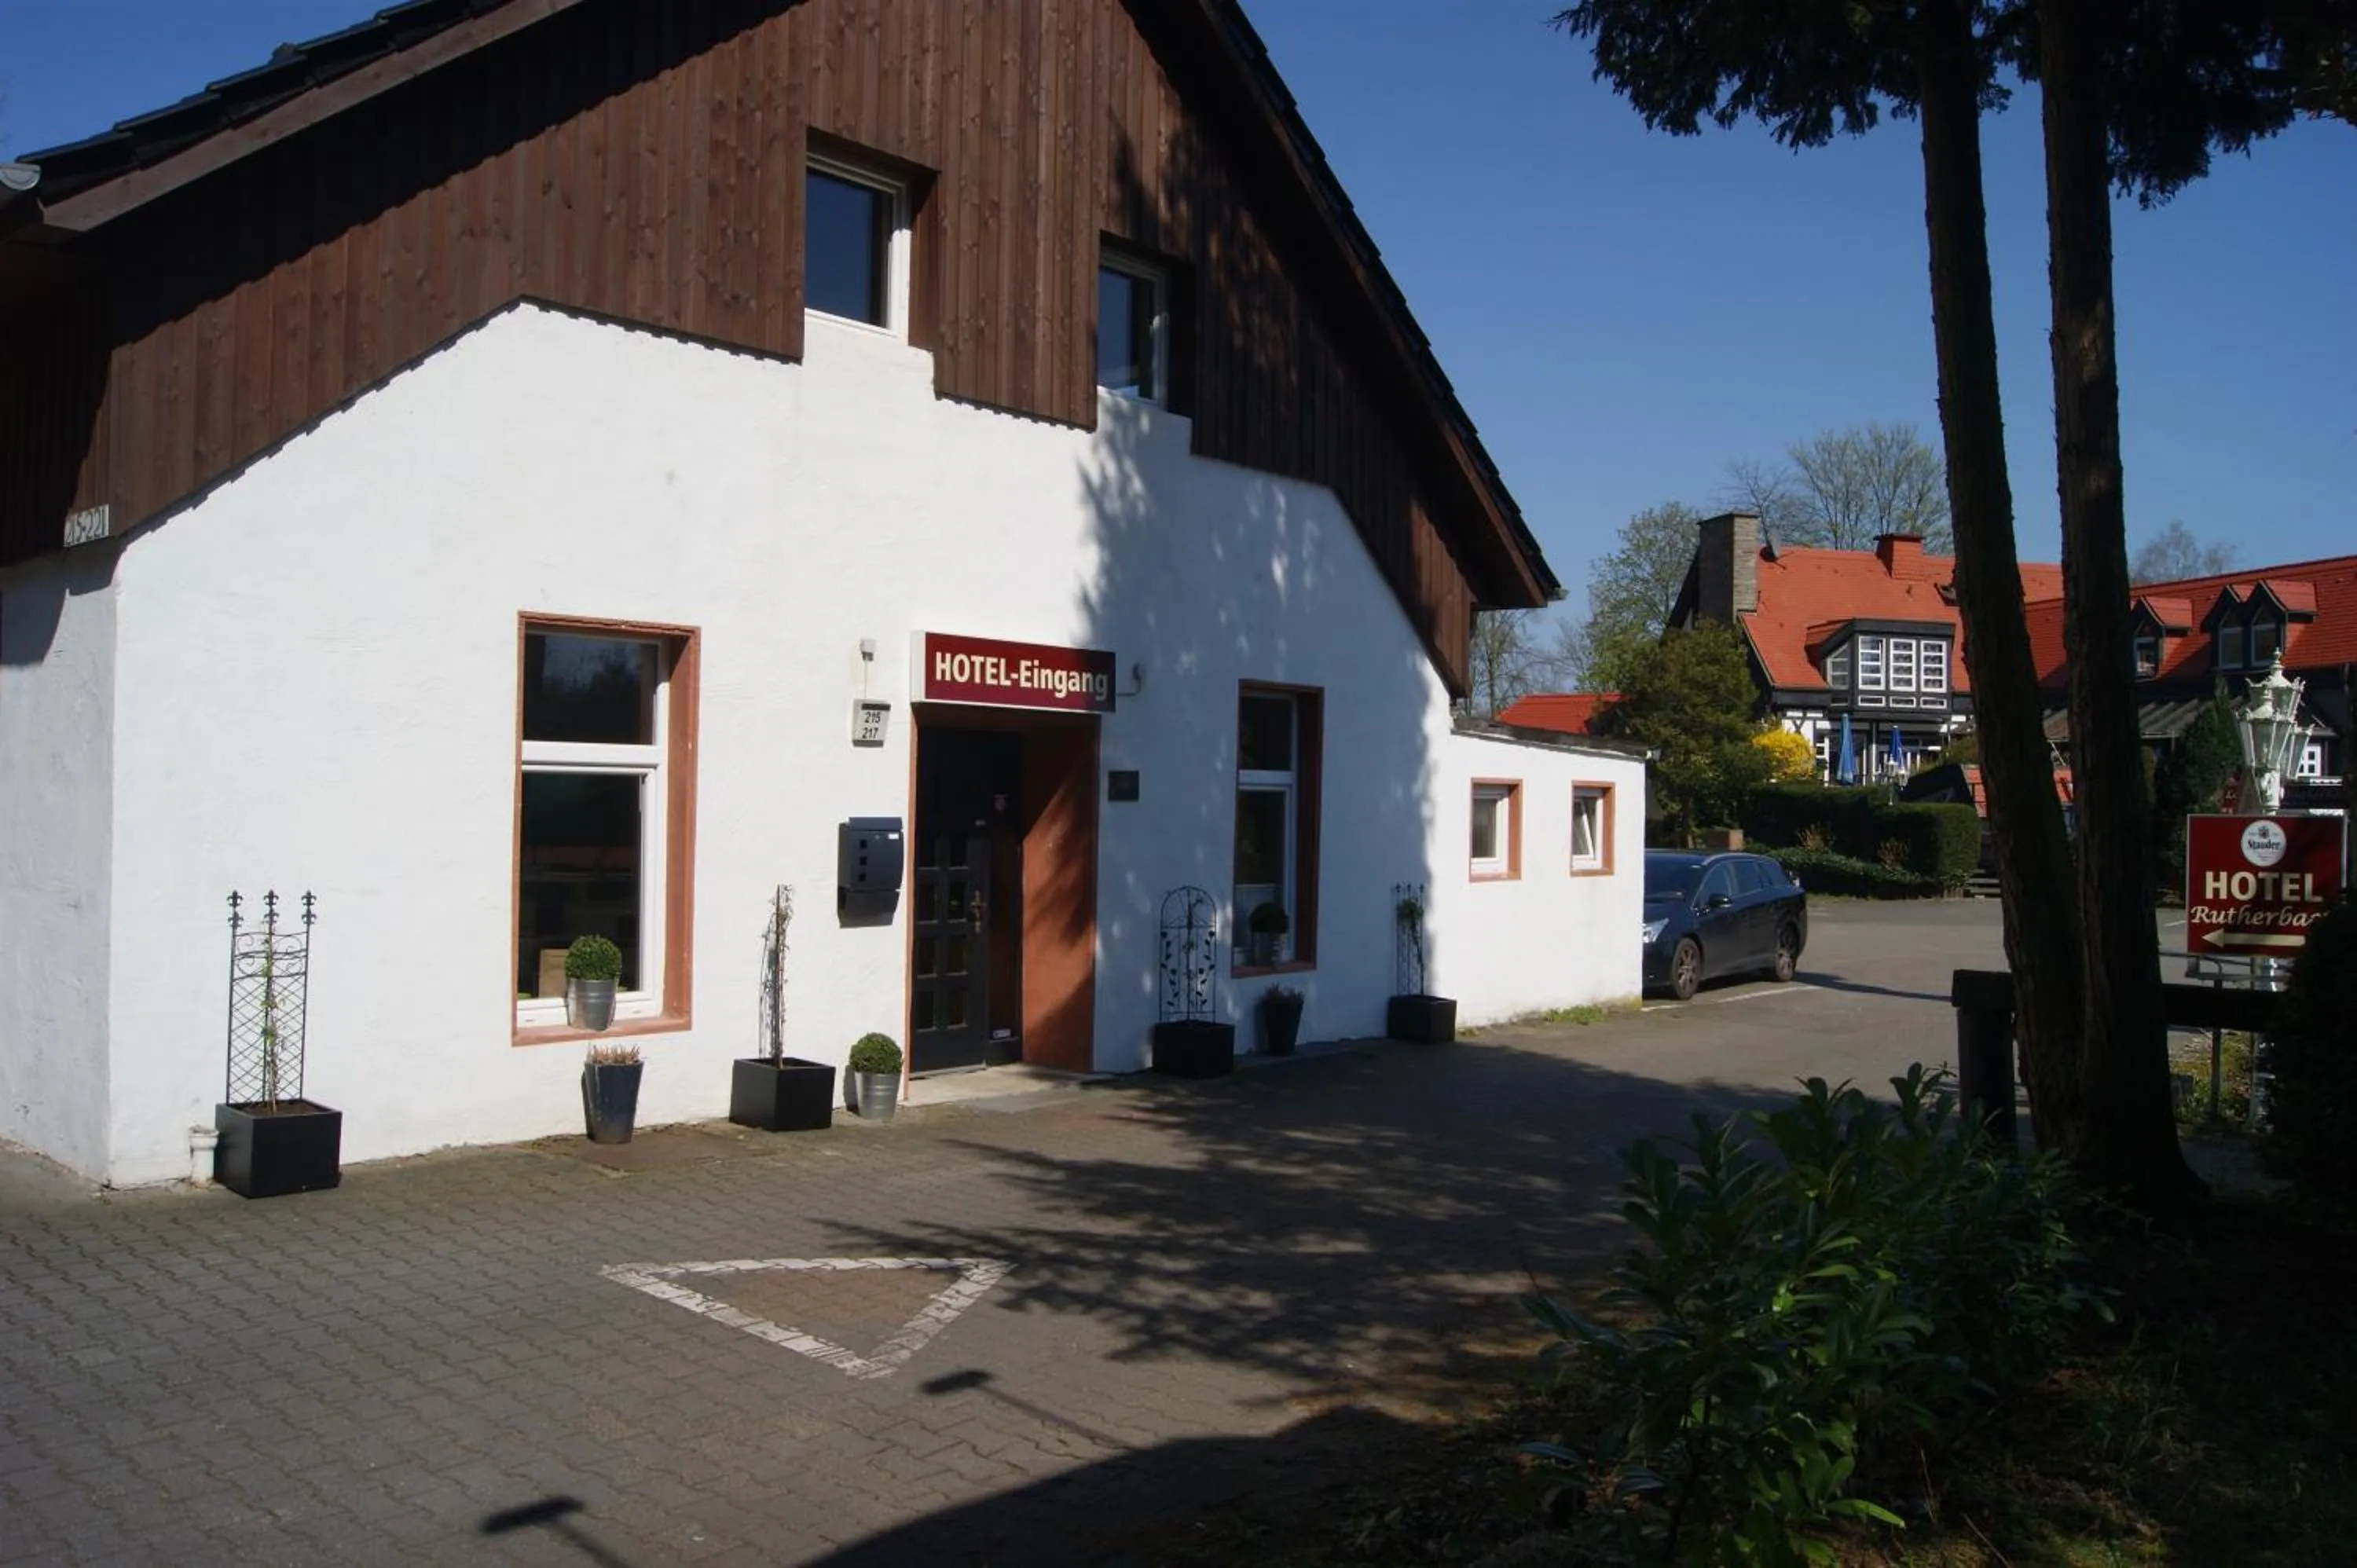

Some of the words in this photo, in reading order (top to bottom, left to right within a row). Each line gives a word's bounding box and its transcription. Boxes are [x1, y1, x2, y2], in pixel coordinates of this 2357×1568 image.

[935, 651, 1108, 700] HOTEL-Eingang
[864, 711, 881, 724] 215
[861, 727, 879, 739] 217
[2205, 870, 2323, 902] HOTEL
[2190, 904, 2330, 927] Rutherba
